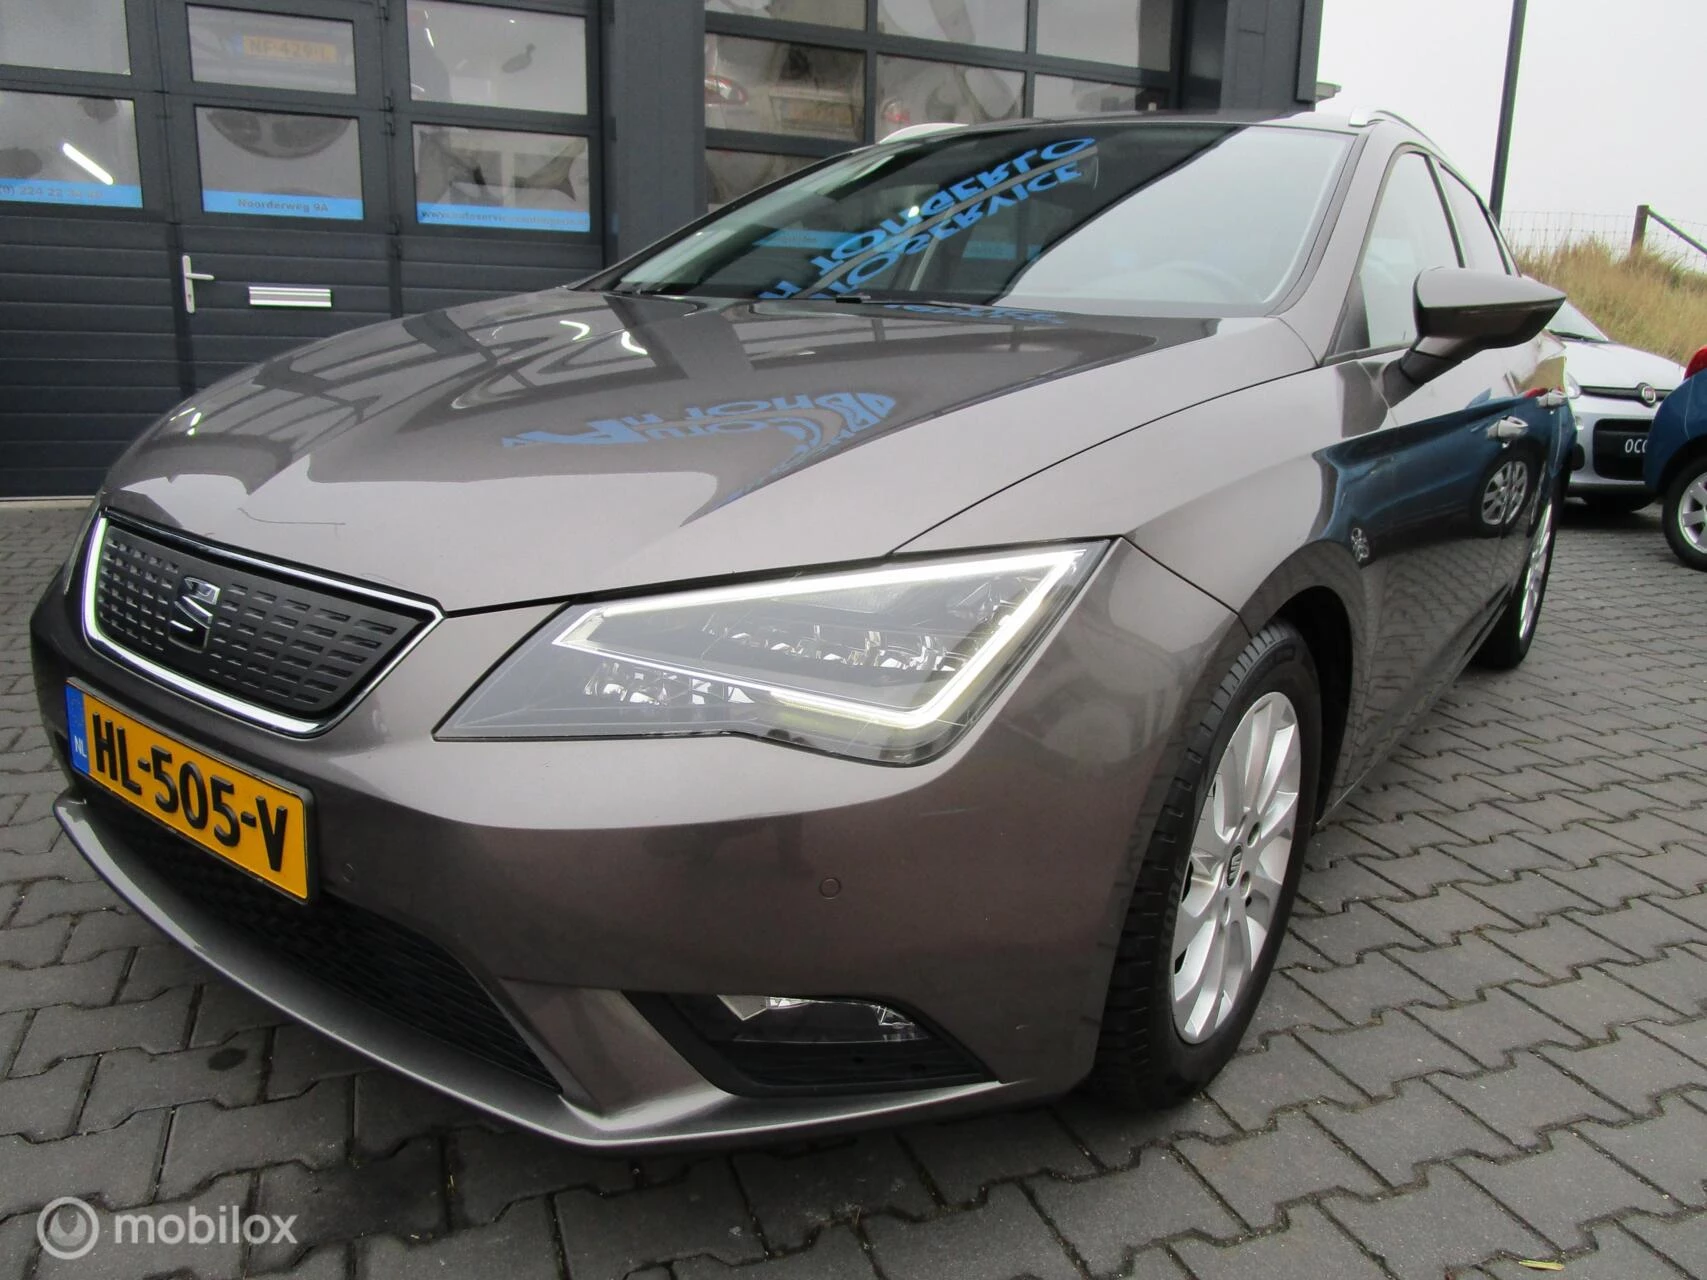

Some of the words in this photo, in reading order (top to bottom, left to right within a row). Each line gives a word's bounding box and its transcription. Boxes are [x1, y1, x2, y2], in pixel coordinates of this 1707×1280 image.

[238, 198, 310, 213] Noorderweg
[74, 735, 87, 758] NL
[92, 712, 288, 872] HL-505-V
